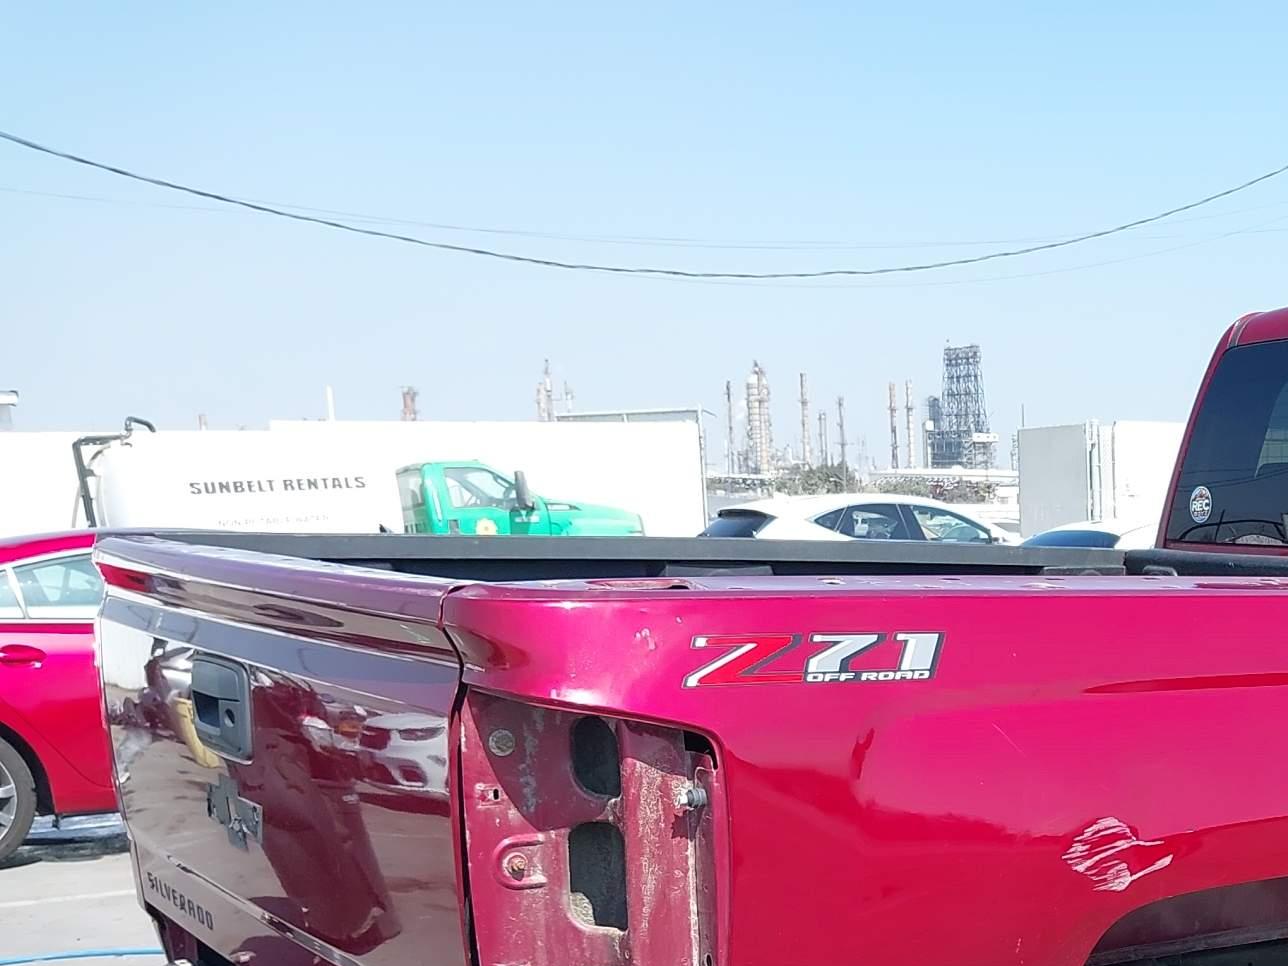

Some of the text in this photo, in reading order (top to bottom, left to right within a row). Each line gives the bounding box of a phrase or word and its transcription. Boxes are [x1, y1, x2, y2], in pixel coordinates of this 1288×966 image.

[190, 476, 366, 495] SUNBELT RENTALS
[1192, 499, 1210, 511] REC
[682, 630, 946, 688] Z71
[807, 670, 930, 682] OFF ROAD
[147, 872, 214, 931] SILVERADO
